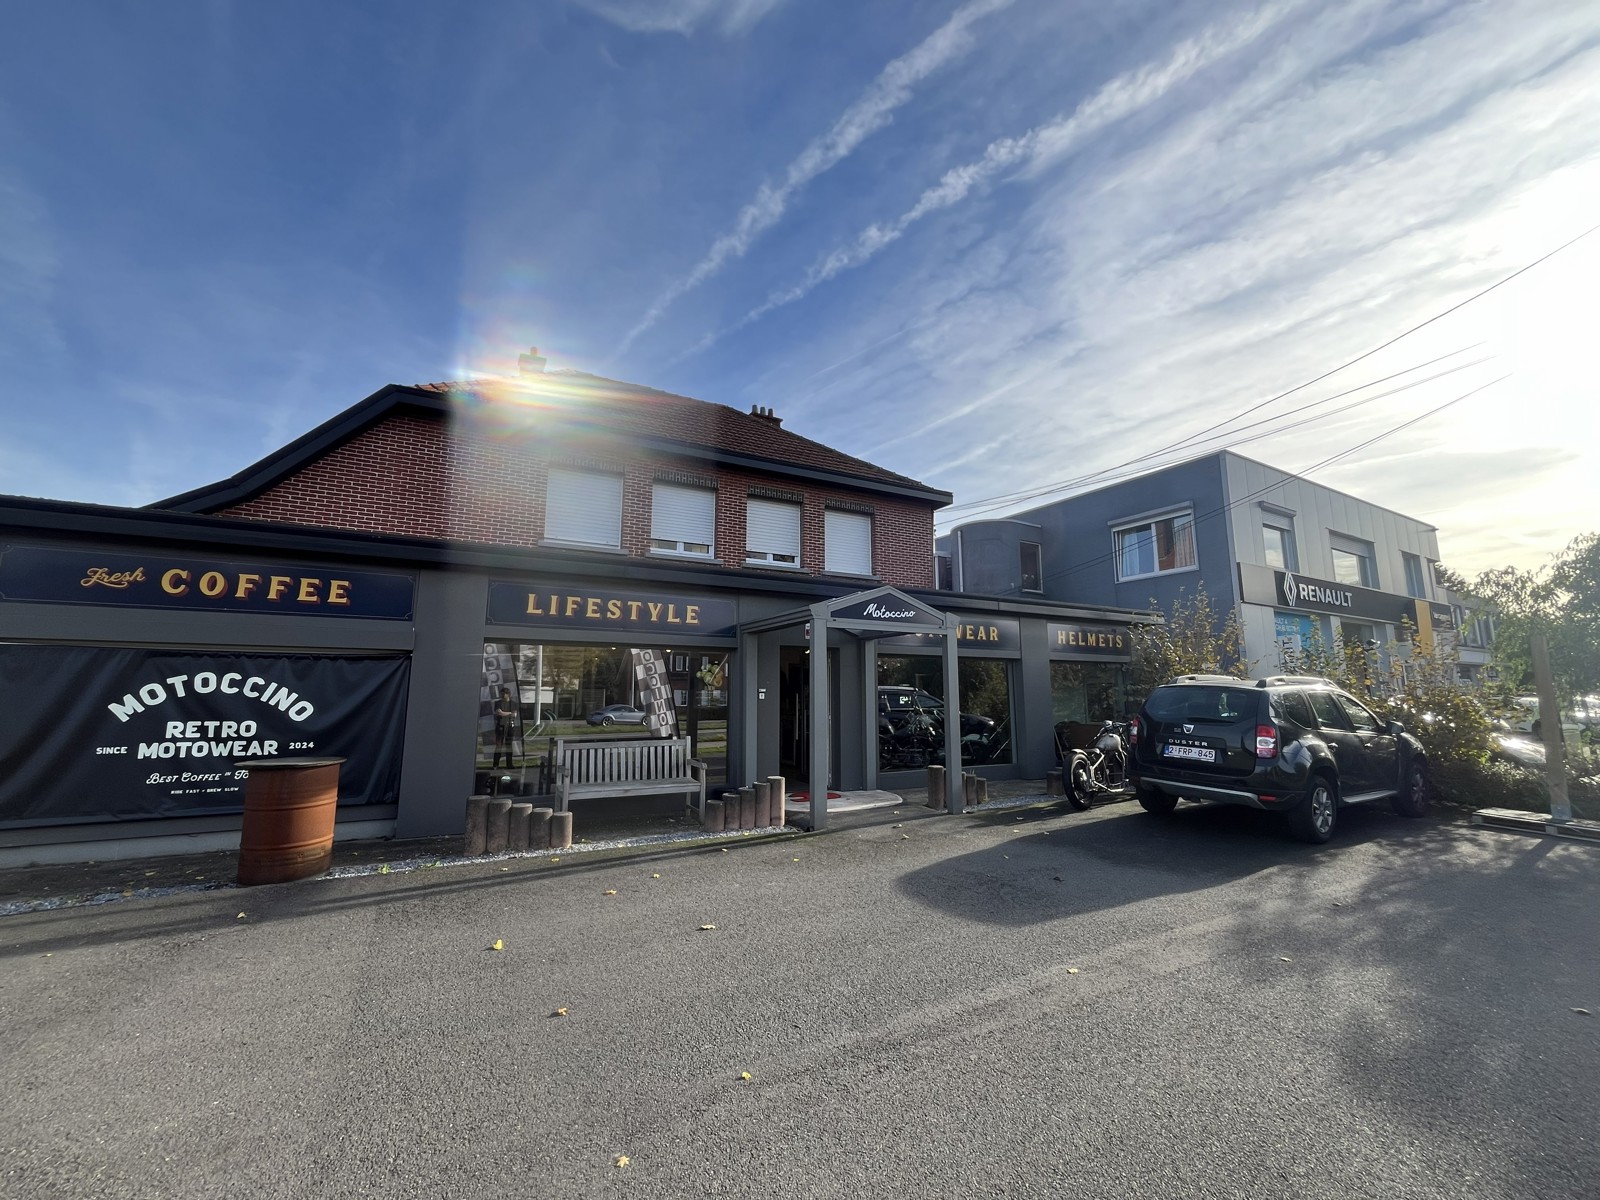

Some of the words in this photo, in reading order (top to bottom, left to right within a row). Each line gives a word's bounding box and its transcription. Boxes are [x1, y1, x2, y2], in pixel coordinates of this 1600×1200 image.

[81, 567, 146, 588] Fresh
[160, 568, 352, 604] COFFEE
[1298, 583, 1353, 608] RENAULT
[526, 593, 700, 624] LIFESTYLE
[863, 603, 916, 618] Motoccino
[1057, 630, 1124, 649] HELMETS
[107, 671, 315, 722] MOTOCCINO
[165, 720, 257, 739] RETRO
[95, 746, 128, 755] SINCE
[137, 740, 279, 759] MOTOWEAR
[288, 741, 315, 750] 2024
[1168, 738, 1208, 747] DUSTER
[234, 769, 250, 780] TO
